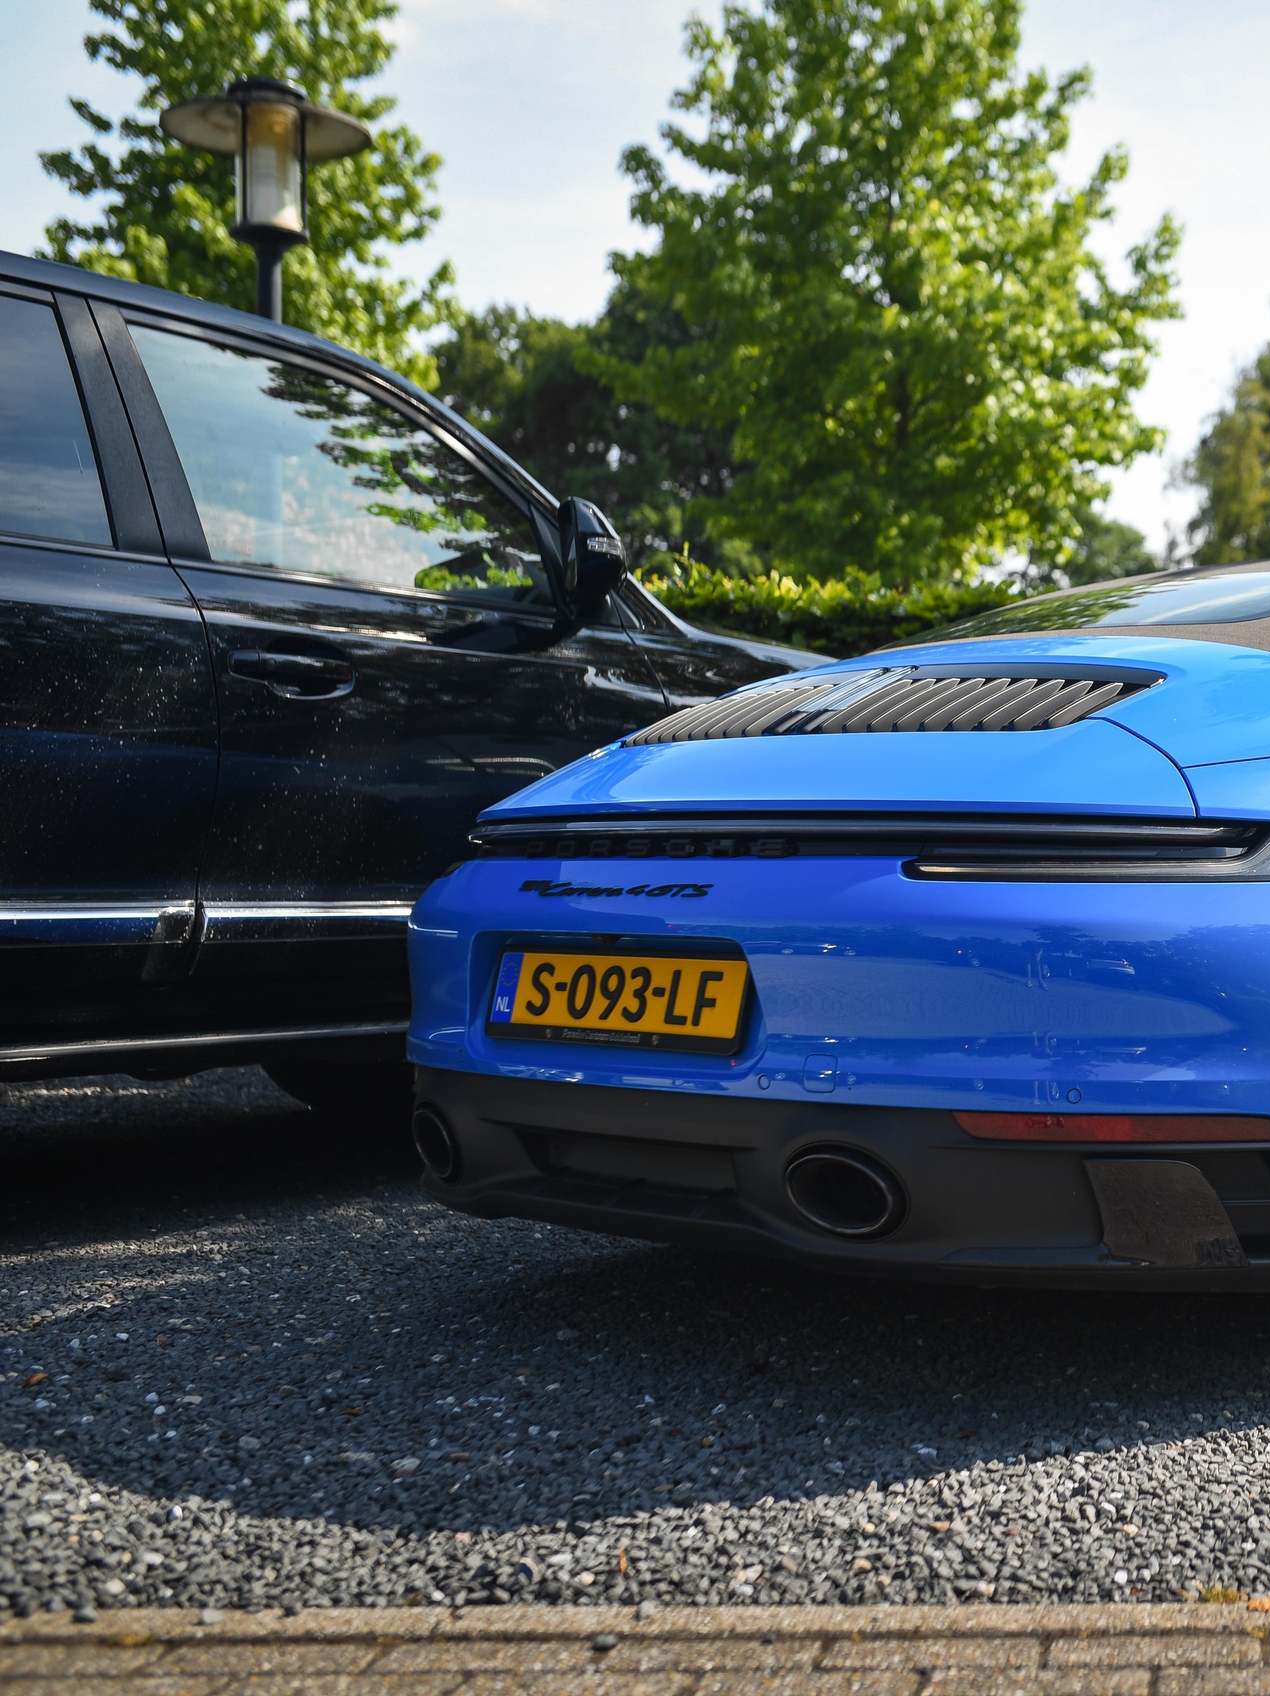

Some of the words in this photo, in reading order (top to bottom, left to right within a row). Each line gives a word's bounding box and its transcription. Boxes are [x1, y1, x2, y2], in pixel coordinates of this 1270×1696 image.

[525, 839, 789, 859] PORSCHE
[538, 881, 624, 898] Carrera
[646, 883, 714, 898] GTS
[525, 962, 725, 1028] S-093-LF
[495, 996, 511, 1013] NL
